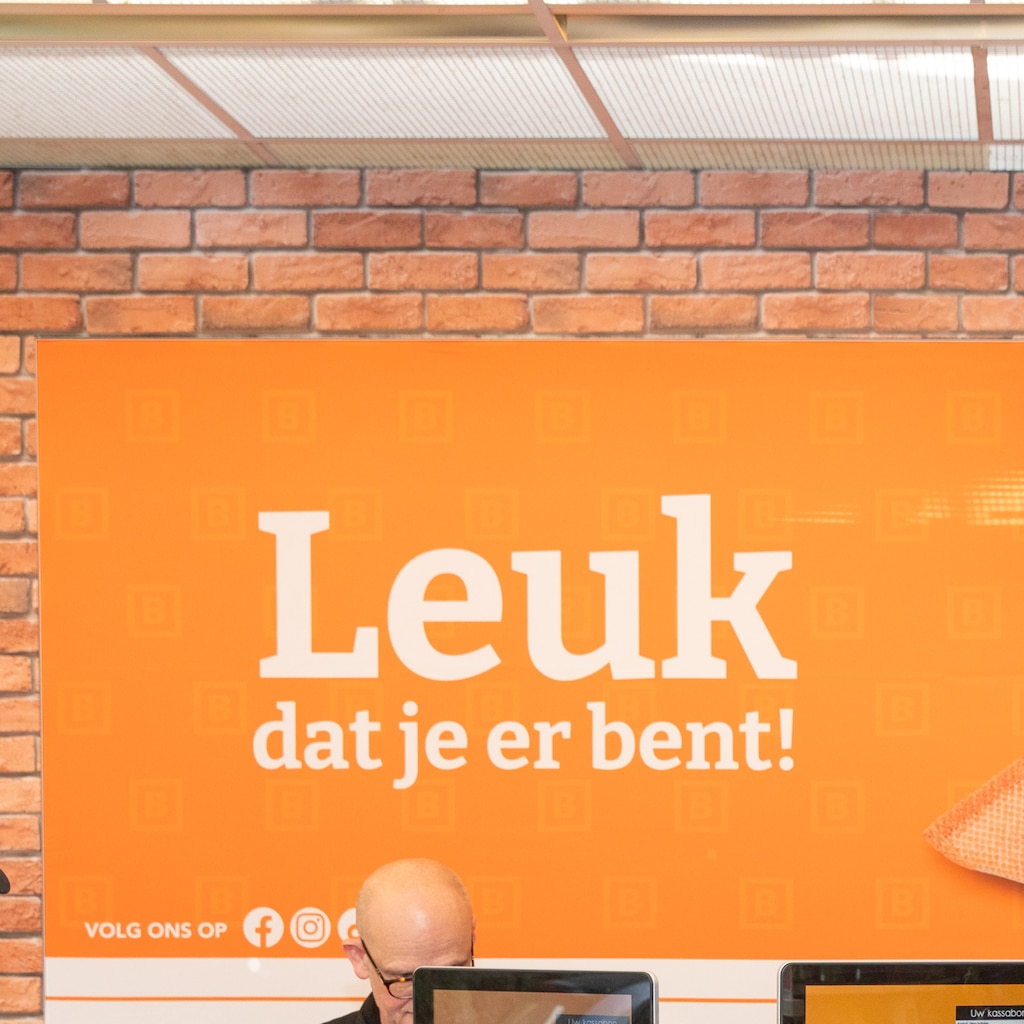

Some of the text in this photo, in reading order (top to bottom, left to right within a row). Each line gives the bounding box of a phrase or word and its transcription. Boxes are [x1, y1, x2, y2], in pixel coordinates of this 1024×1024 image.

[258, 494, 798, 681] Leuk
[253, 701, 795, 790] dat je er bent!
[84, 922, 228, 939] VOLG ONS OP
[970, 1009, 985, 1018] Uw
